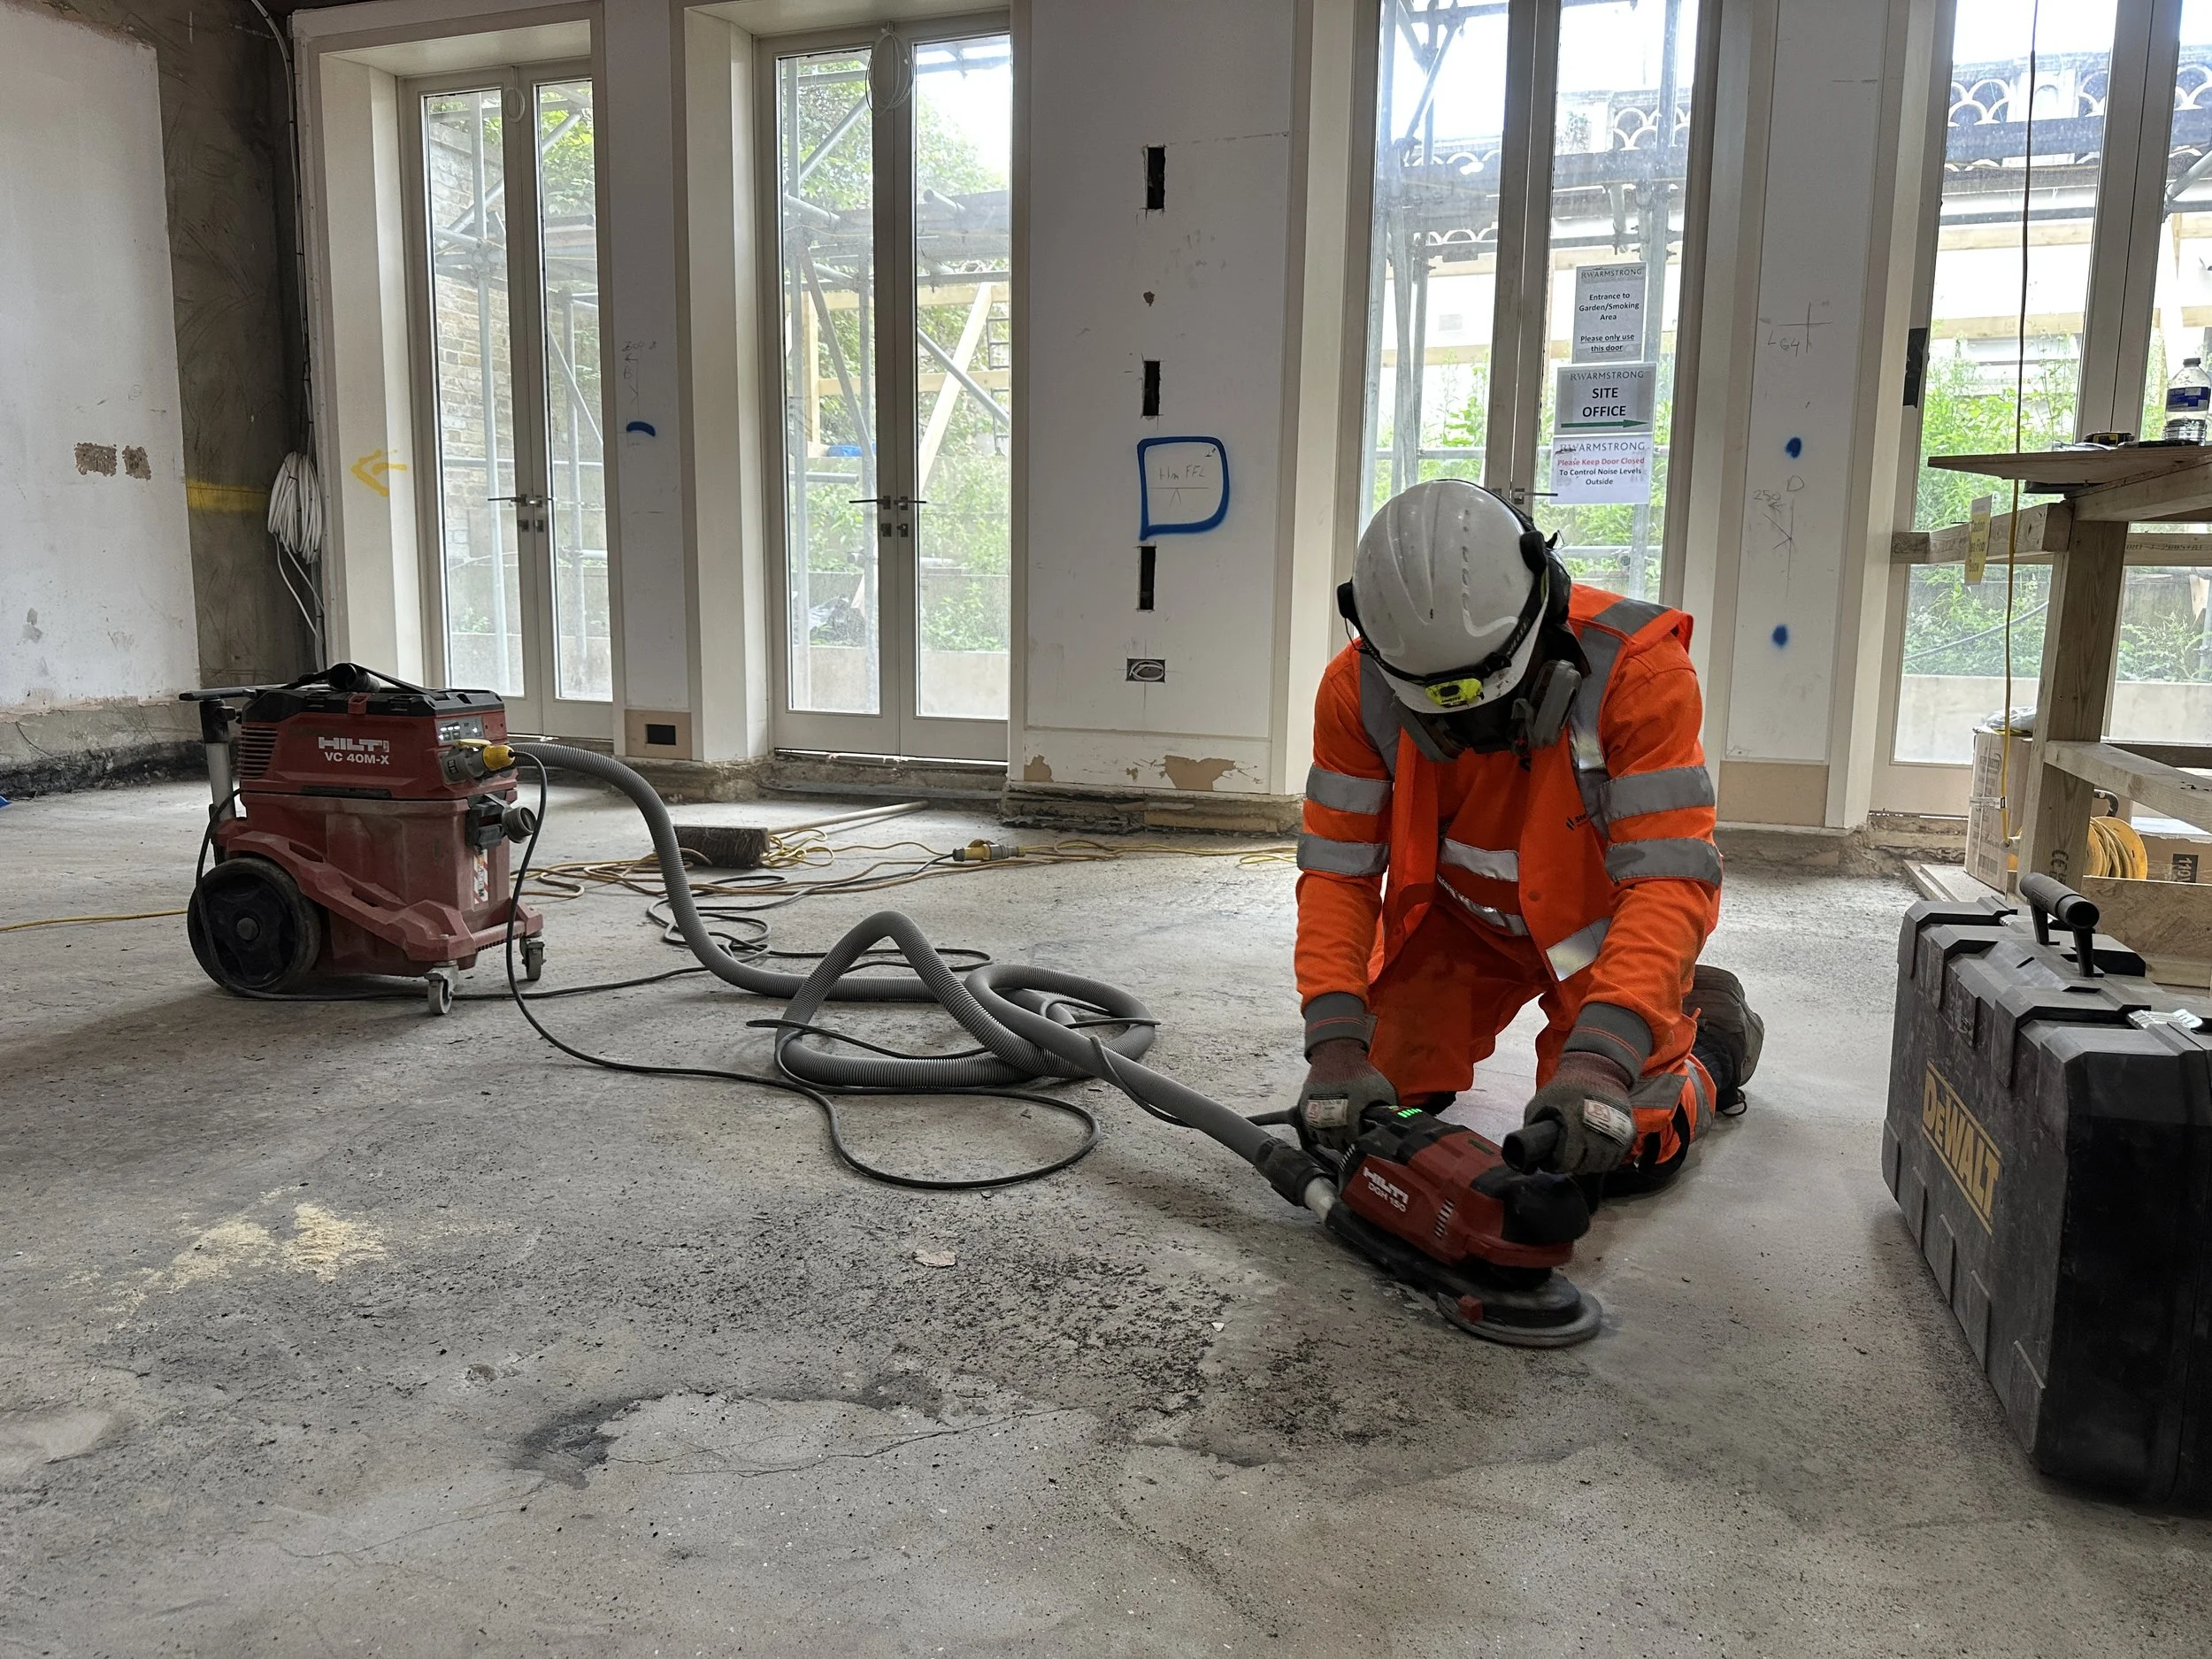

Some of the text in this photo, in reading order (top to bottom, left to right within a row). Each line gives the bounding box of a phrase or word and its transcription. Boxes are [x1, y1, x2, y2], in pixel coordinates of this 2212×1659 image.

[1581, 268, 1642, 280] RWARMSTRONG
[1578, 303, 1640, 312] Garden/Smoking
[1570, 371, 1644, 381] RWARMSTRONG
[1592, 387, 1619, 399] SITE
[1582, 405, 1626, 418] OFFICE
[319, 736, 390, 753] HILTI
[324, 752, 389, 764] VC 40M-X
[1363, 1166, 1409, 1204] HILTI
[1368, 1181, 1407, 1212] DGH 150
